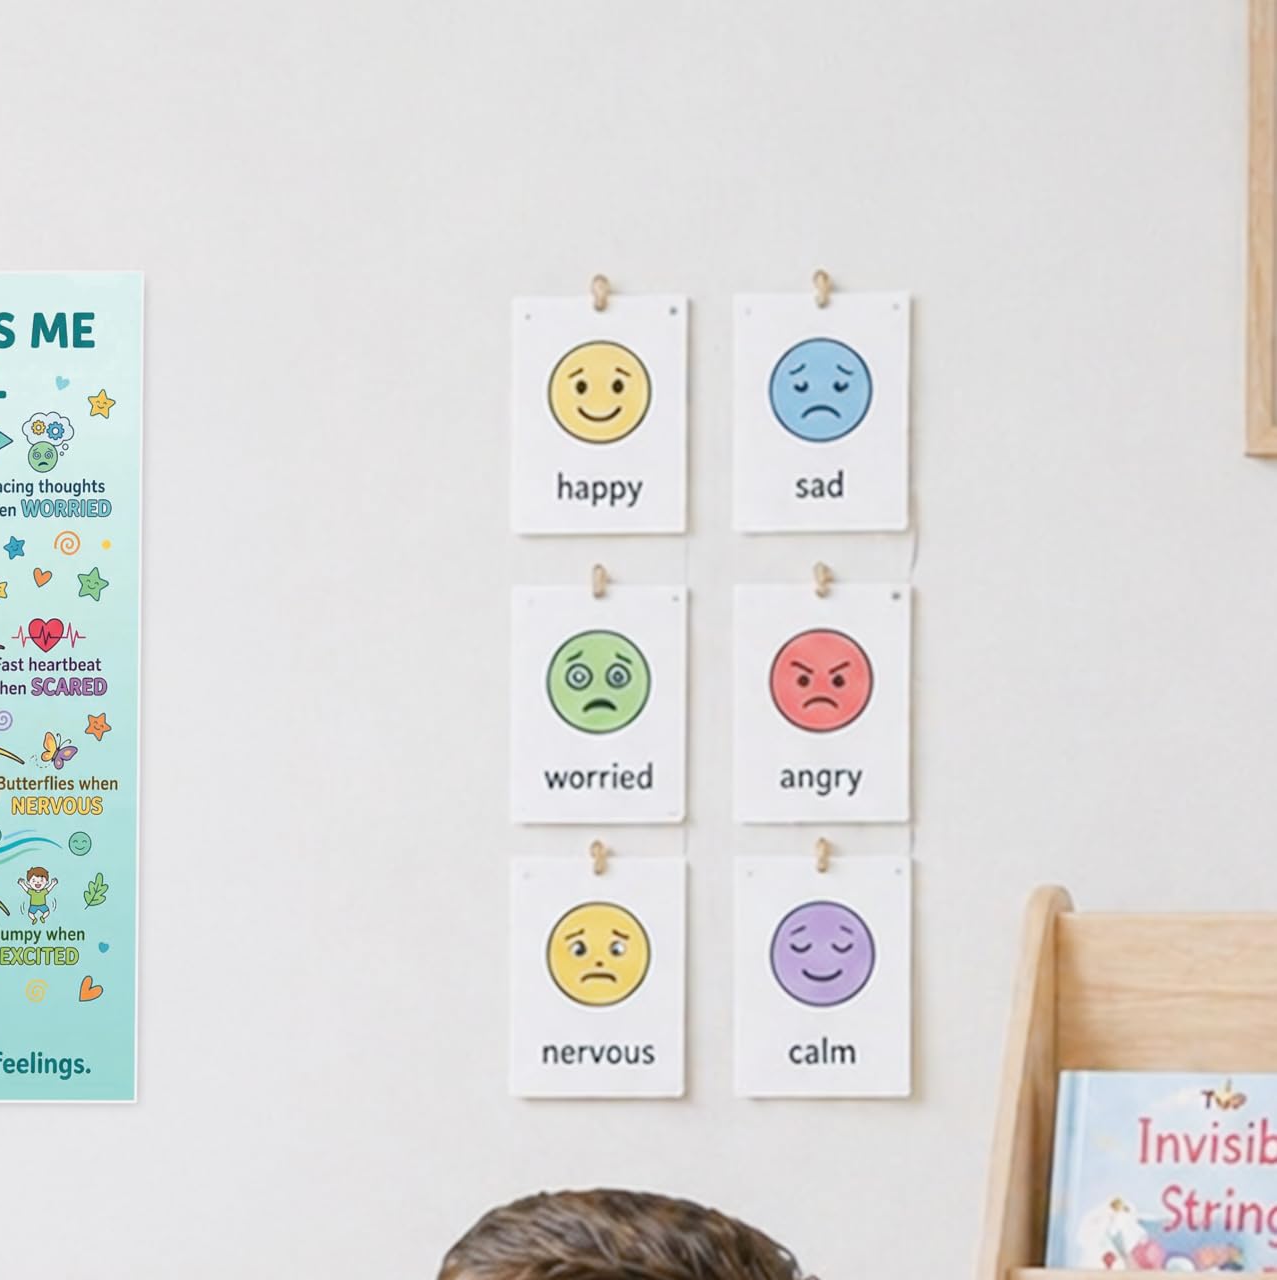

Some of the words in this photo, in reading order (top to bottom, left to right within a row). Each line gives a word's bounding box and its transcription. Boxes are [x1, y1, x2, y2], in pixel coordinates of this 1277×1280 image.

[31, 312, 95, 348] ME
[39, 479, 105, 497] thoughts
[558, 472, 642, 507] happy
[796, 470, 843, 498] sad
[21, 499, 112, 518] WORRIED
[29, 657, 101, 671] heartbeat
[31, 677, 107, 696] SCARED
[79, 776, 117, 790] when
[545, 763, 652, 789] worried
[780, 769, 862, 796] angry
[12, 796, 103, 815] NERVOUS
[46, 927, 84, 941] when
[0, 947, 79, 965] EXCITED
[543, 1045, 655, 1064] nervous
[789, 1037, 855, 1064] calm
